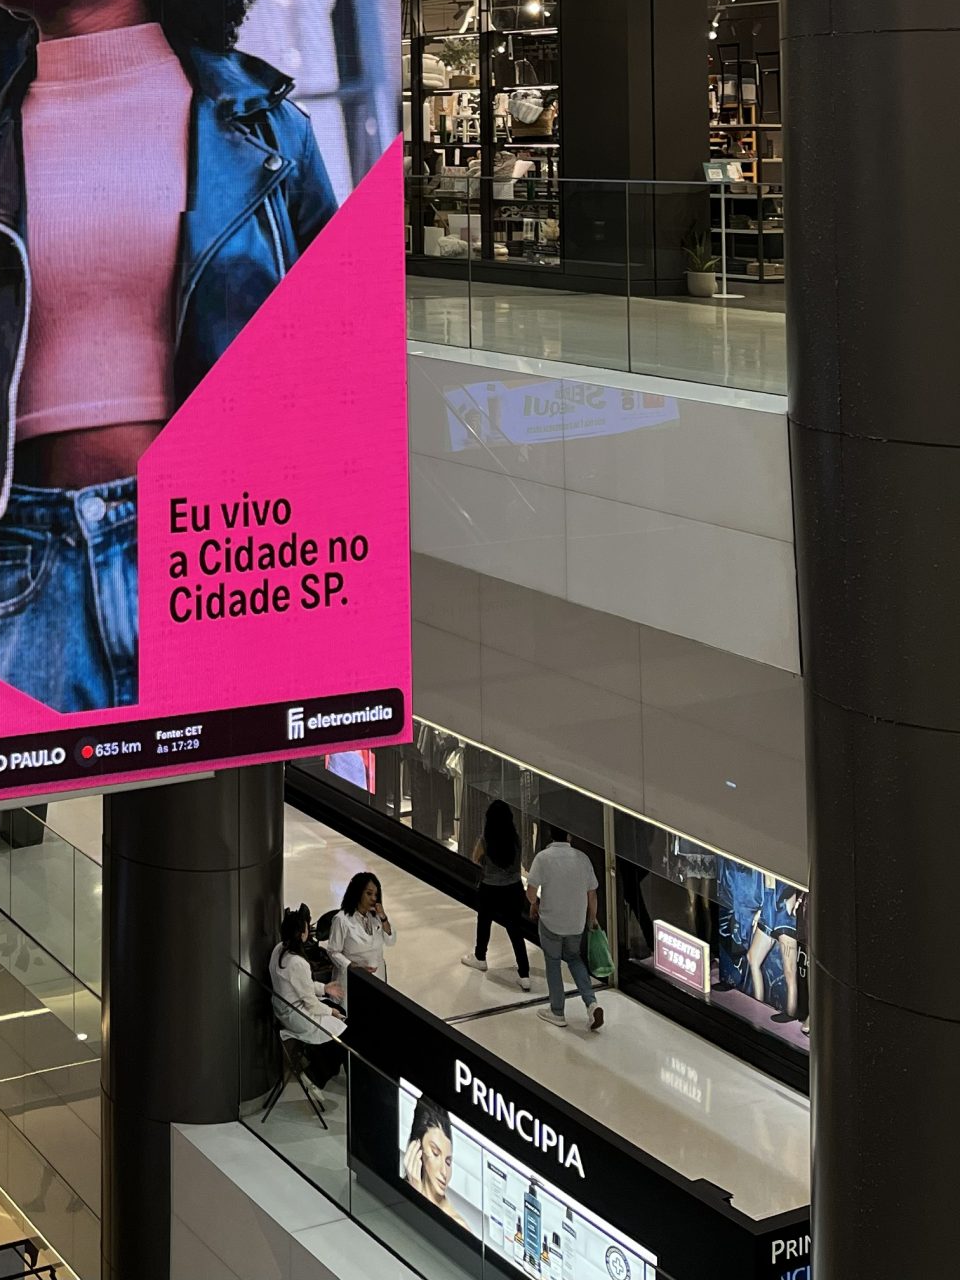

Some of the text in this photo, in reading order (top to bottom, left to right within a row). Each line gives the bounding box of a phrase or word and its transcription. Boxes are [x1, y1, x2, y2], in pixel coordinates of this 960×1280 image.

[170, 491, 291, 533] Eu vivo
[169, 532, 368, 579] a Cidade no
[169, 572, 348, 623] Cidade SP.
[156, 725, 202, 740] Fonte: CET
[307, 706, 393, 730] eletromidia
[11, 747, 66, 770] PAULO
[95, 743, 119, 757] 635
[121, 741, 142, 754] km
[156, 739, 200, 754] às 17:29
[455, 1058, 586, 1179] PRINCIPIA
